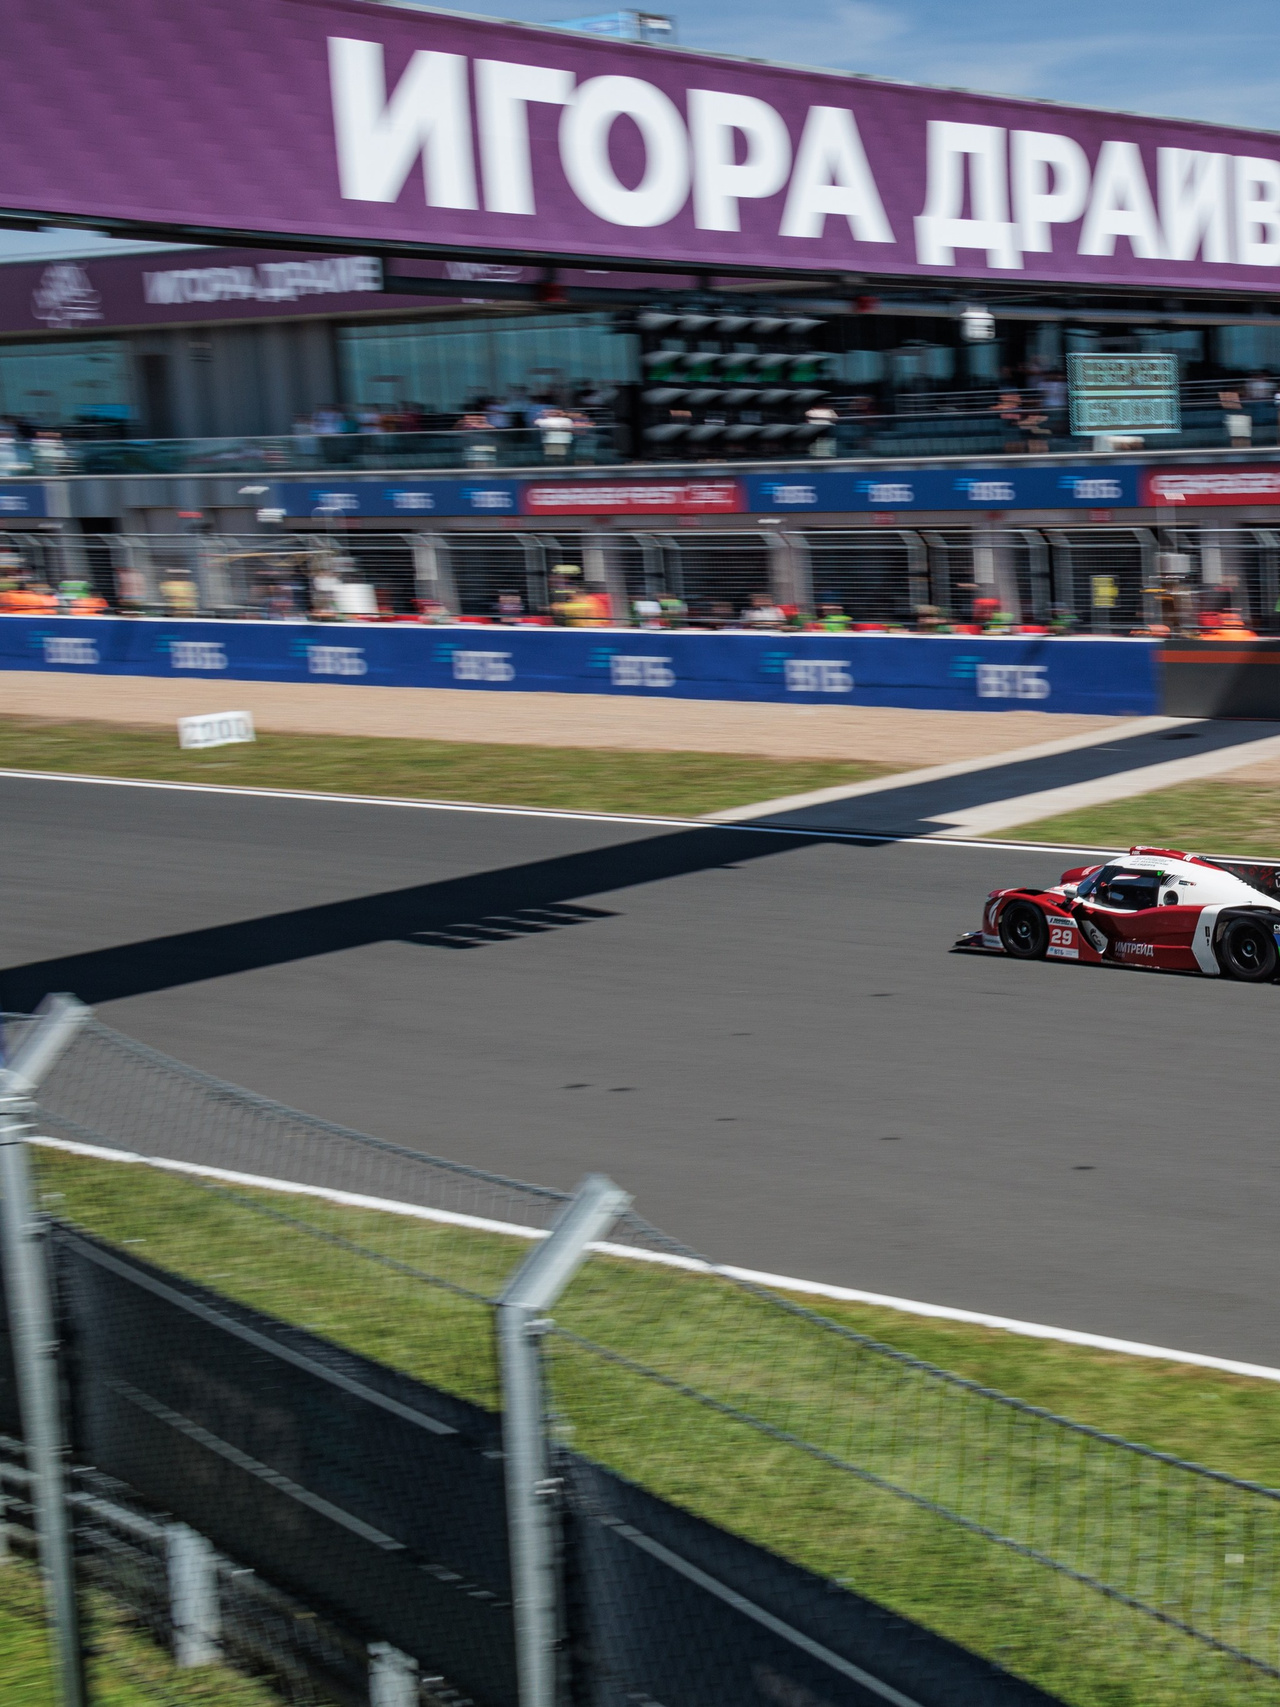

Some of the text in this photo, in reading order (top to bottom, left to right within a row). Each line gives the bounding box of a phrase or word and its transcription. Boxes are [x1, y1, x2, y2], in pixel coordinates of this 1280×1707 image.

[327, 36, 896, 244] ИГОРА
[1051, 929, 1073, 945] 29
[1114, 941, 1154, 957] ИМТРЕЙД
